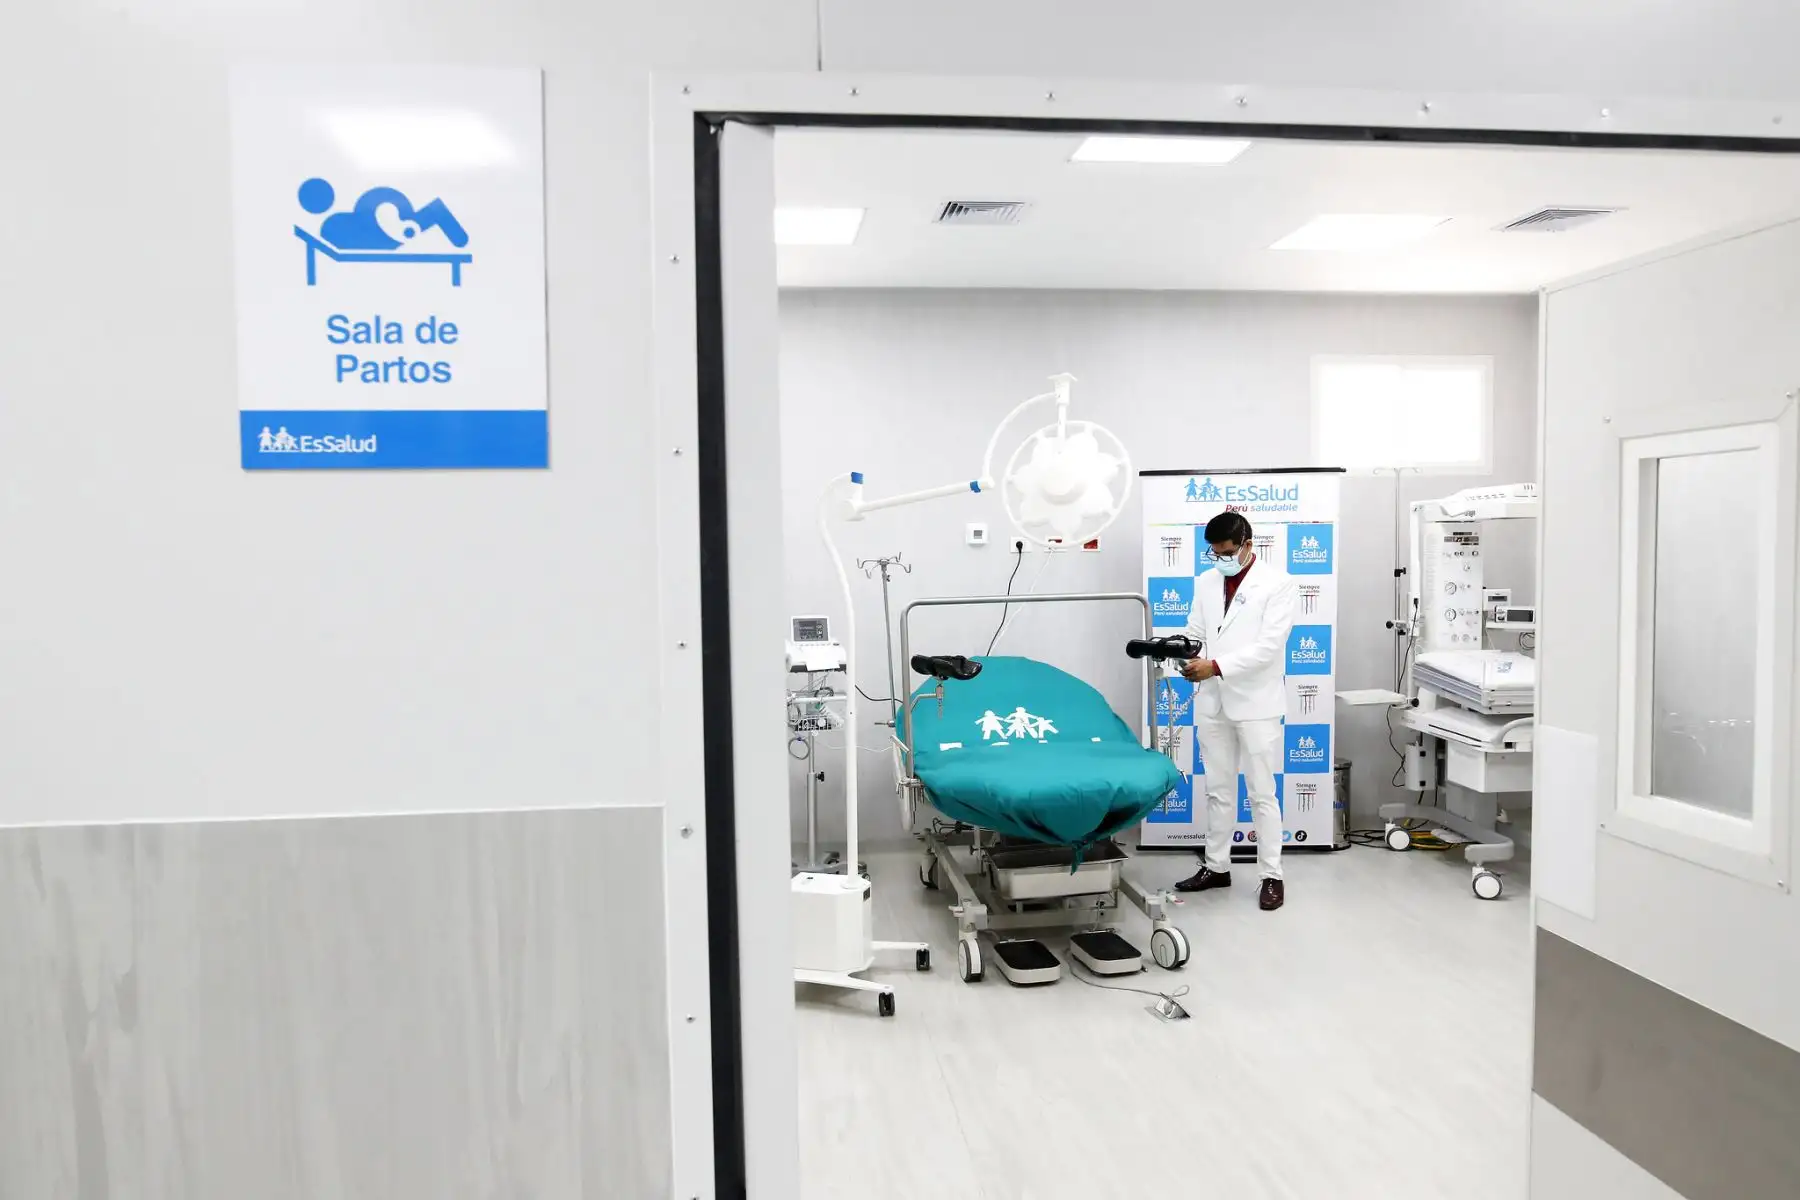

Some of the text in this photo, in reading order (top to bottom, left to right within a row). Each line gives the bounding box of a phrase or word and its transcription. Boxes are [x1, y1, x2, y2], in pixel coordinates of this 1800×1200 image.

[327, 314, 459, 345] Sala de
[336, 354, 452, 384] Partos
[300, 434, 377, 454] EsSalud
[1225, 483, 1298, 501] EsSalud
[1225, 503, 1298, 512] Perú saludable
[1292, 548, 1327, 558] EsSalud
[1153, 602, 1189, 611] EsSalud
[1291, 649, 1326, 659] EsSalud
[1290, 748, 1323, 758] EsSalud
